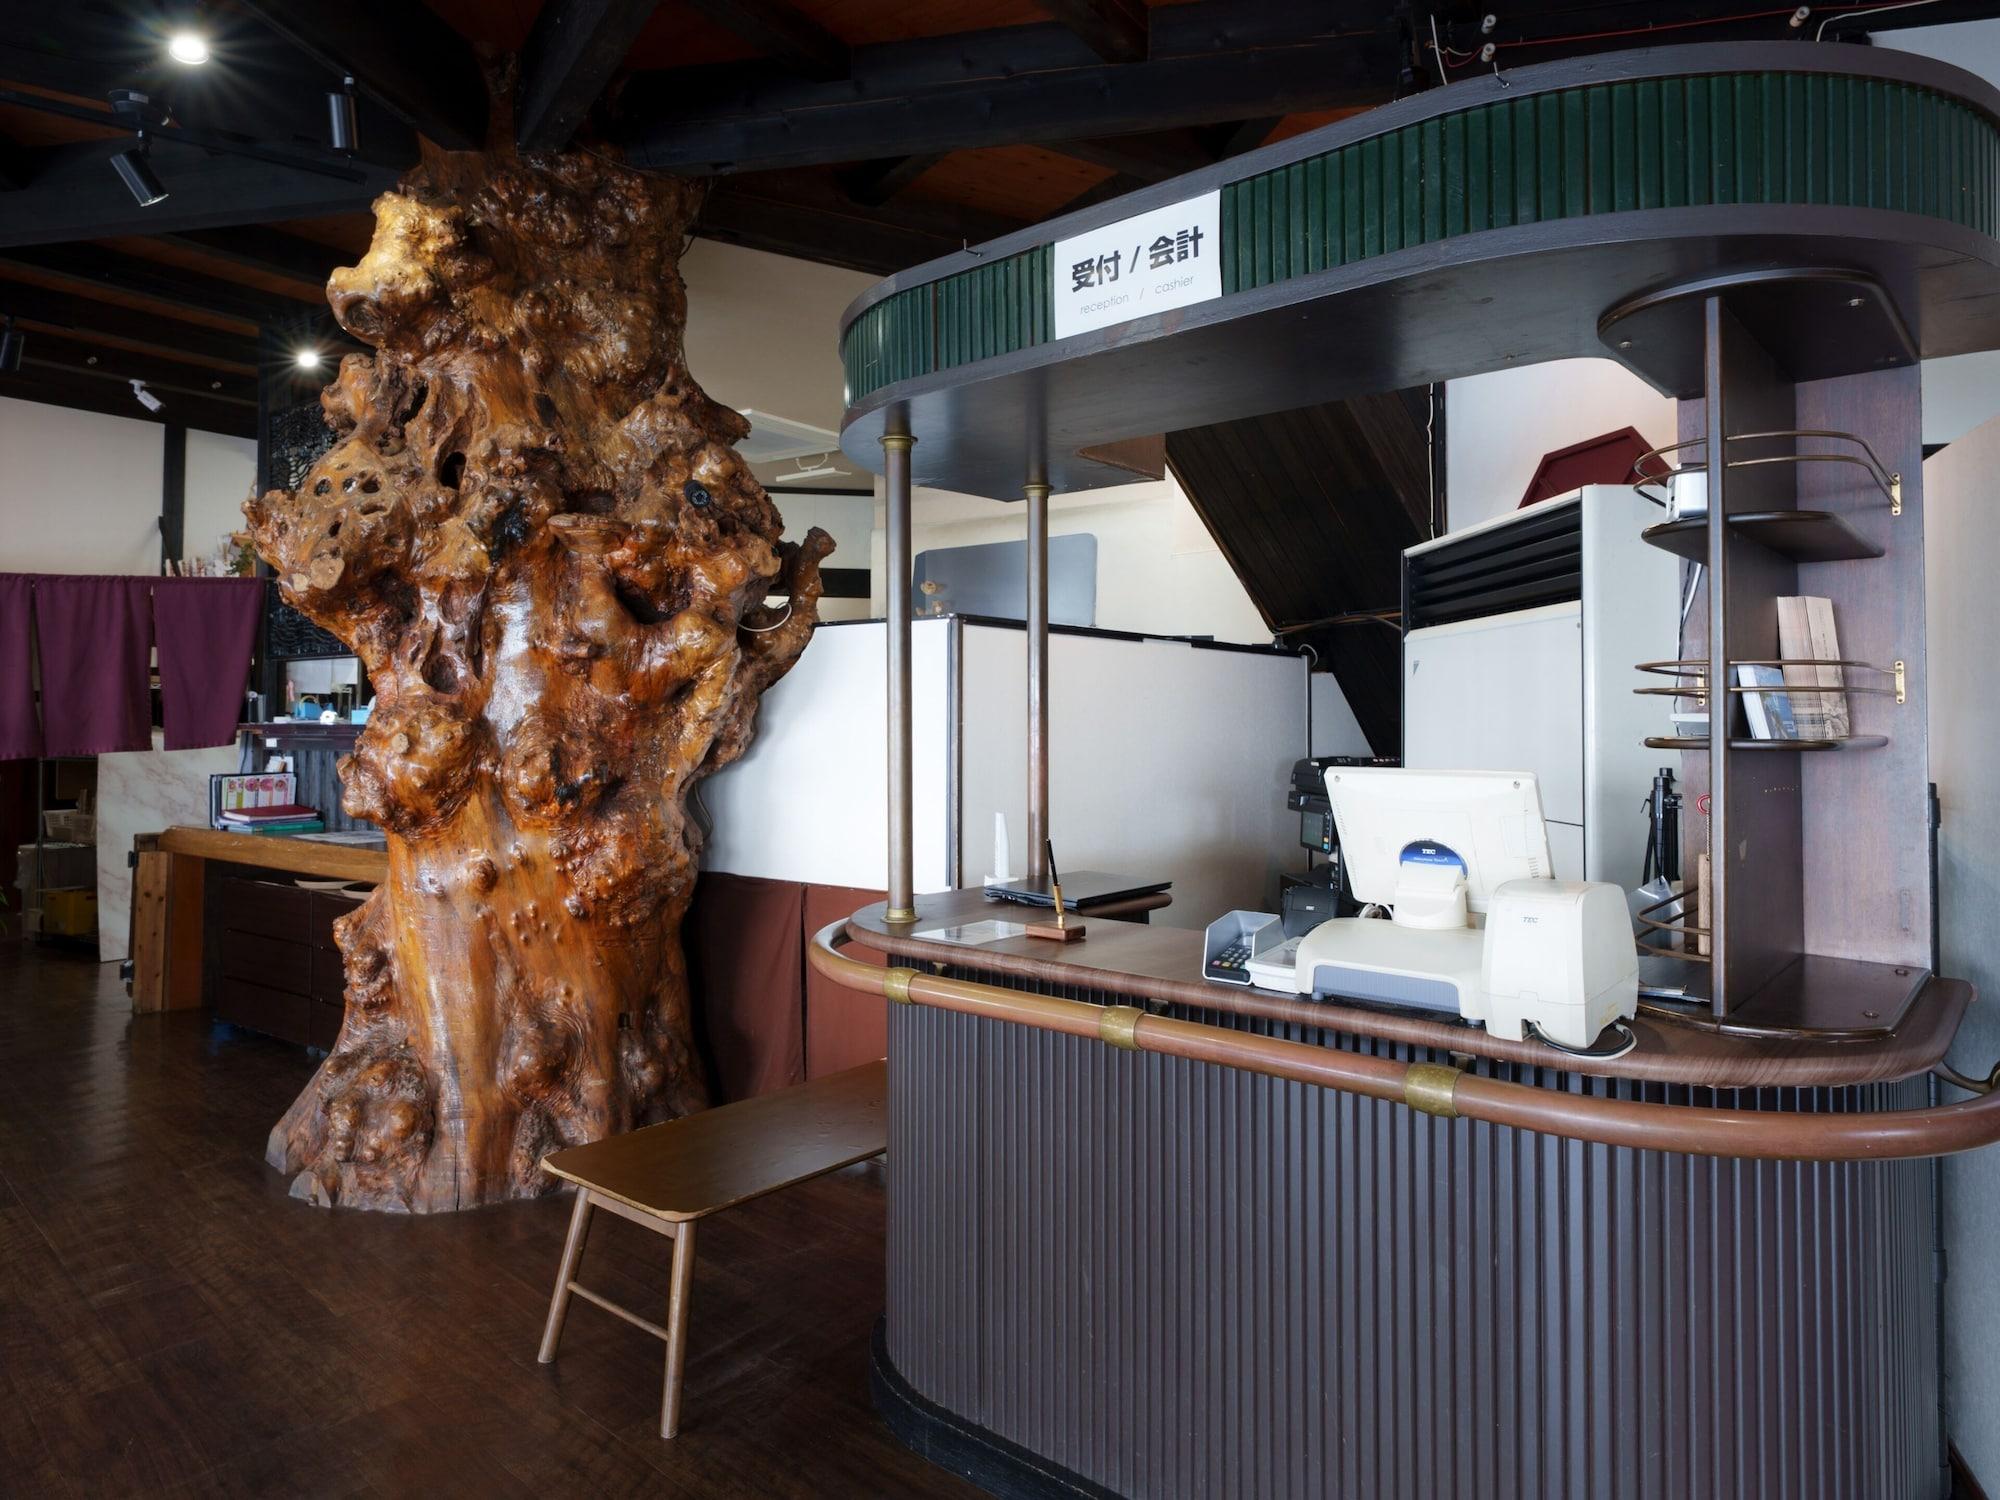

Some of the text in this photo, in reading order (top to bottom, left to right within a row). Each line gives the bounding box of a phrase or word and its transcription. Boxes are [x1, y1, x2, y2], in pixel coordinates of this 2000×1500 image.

[1072, 225, 1204, 293] 受付 / 会計
[1080, 293, 1129, 315] reception
[1154, 275, 1194, 294] cashier
